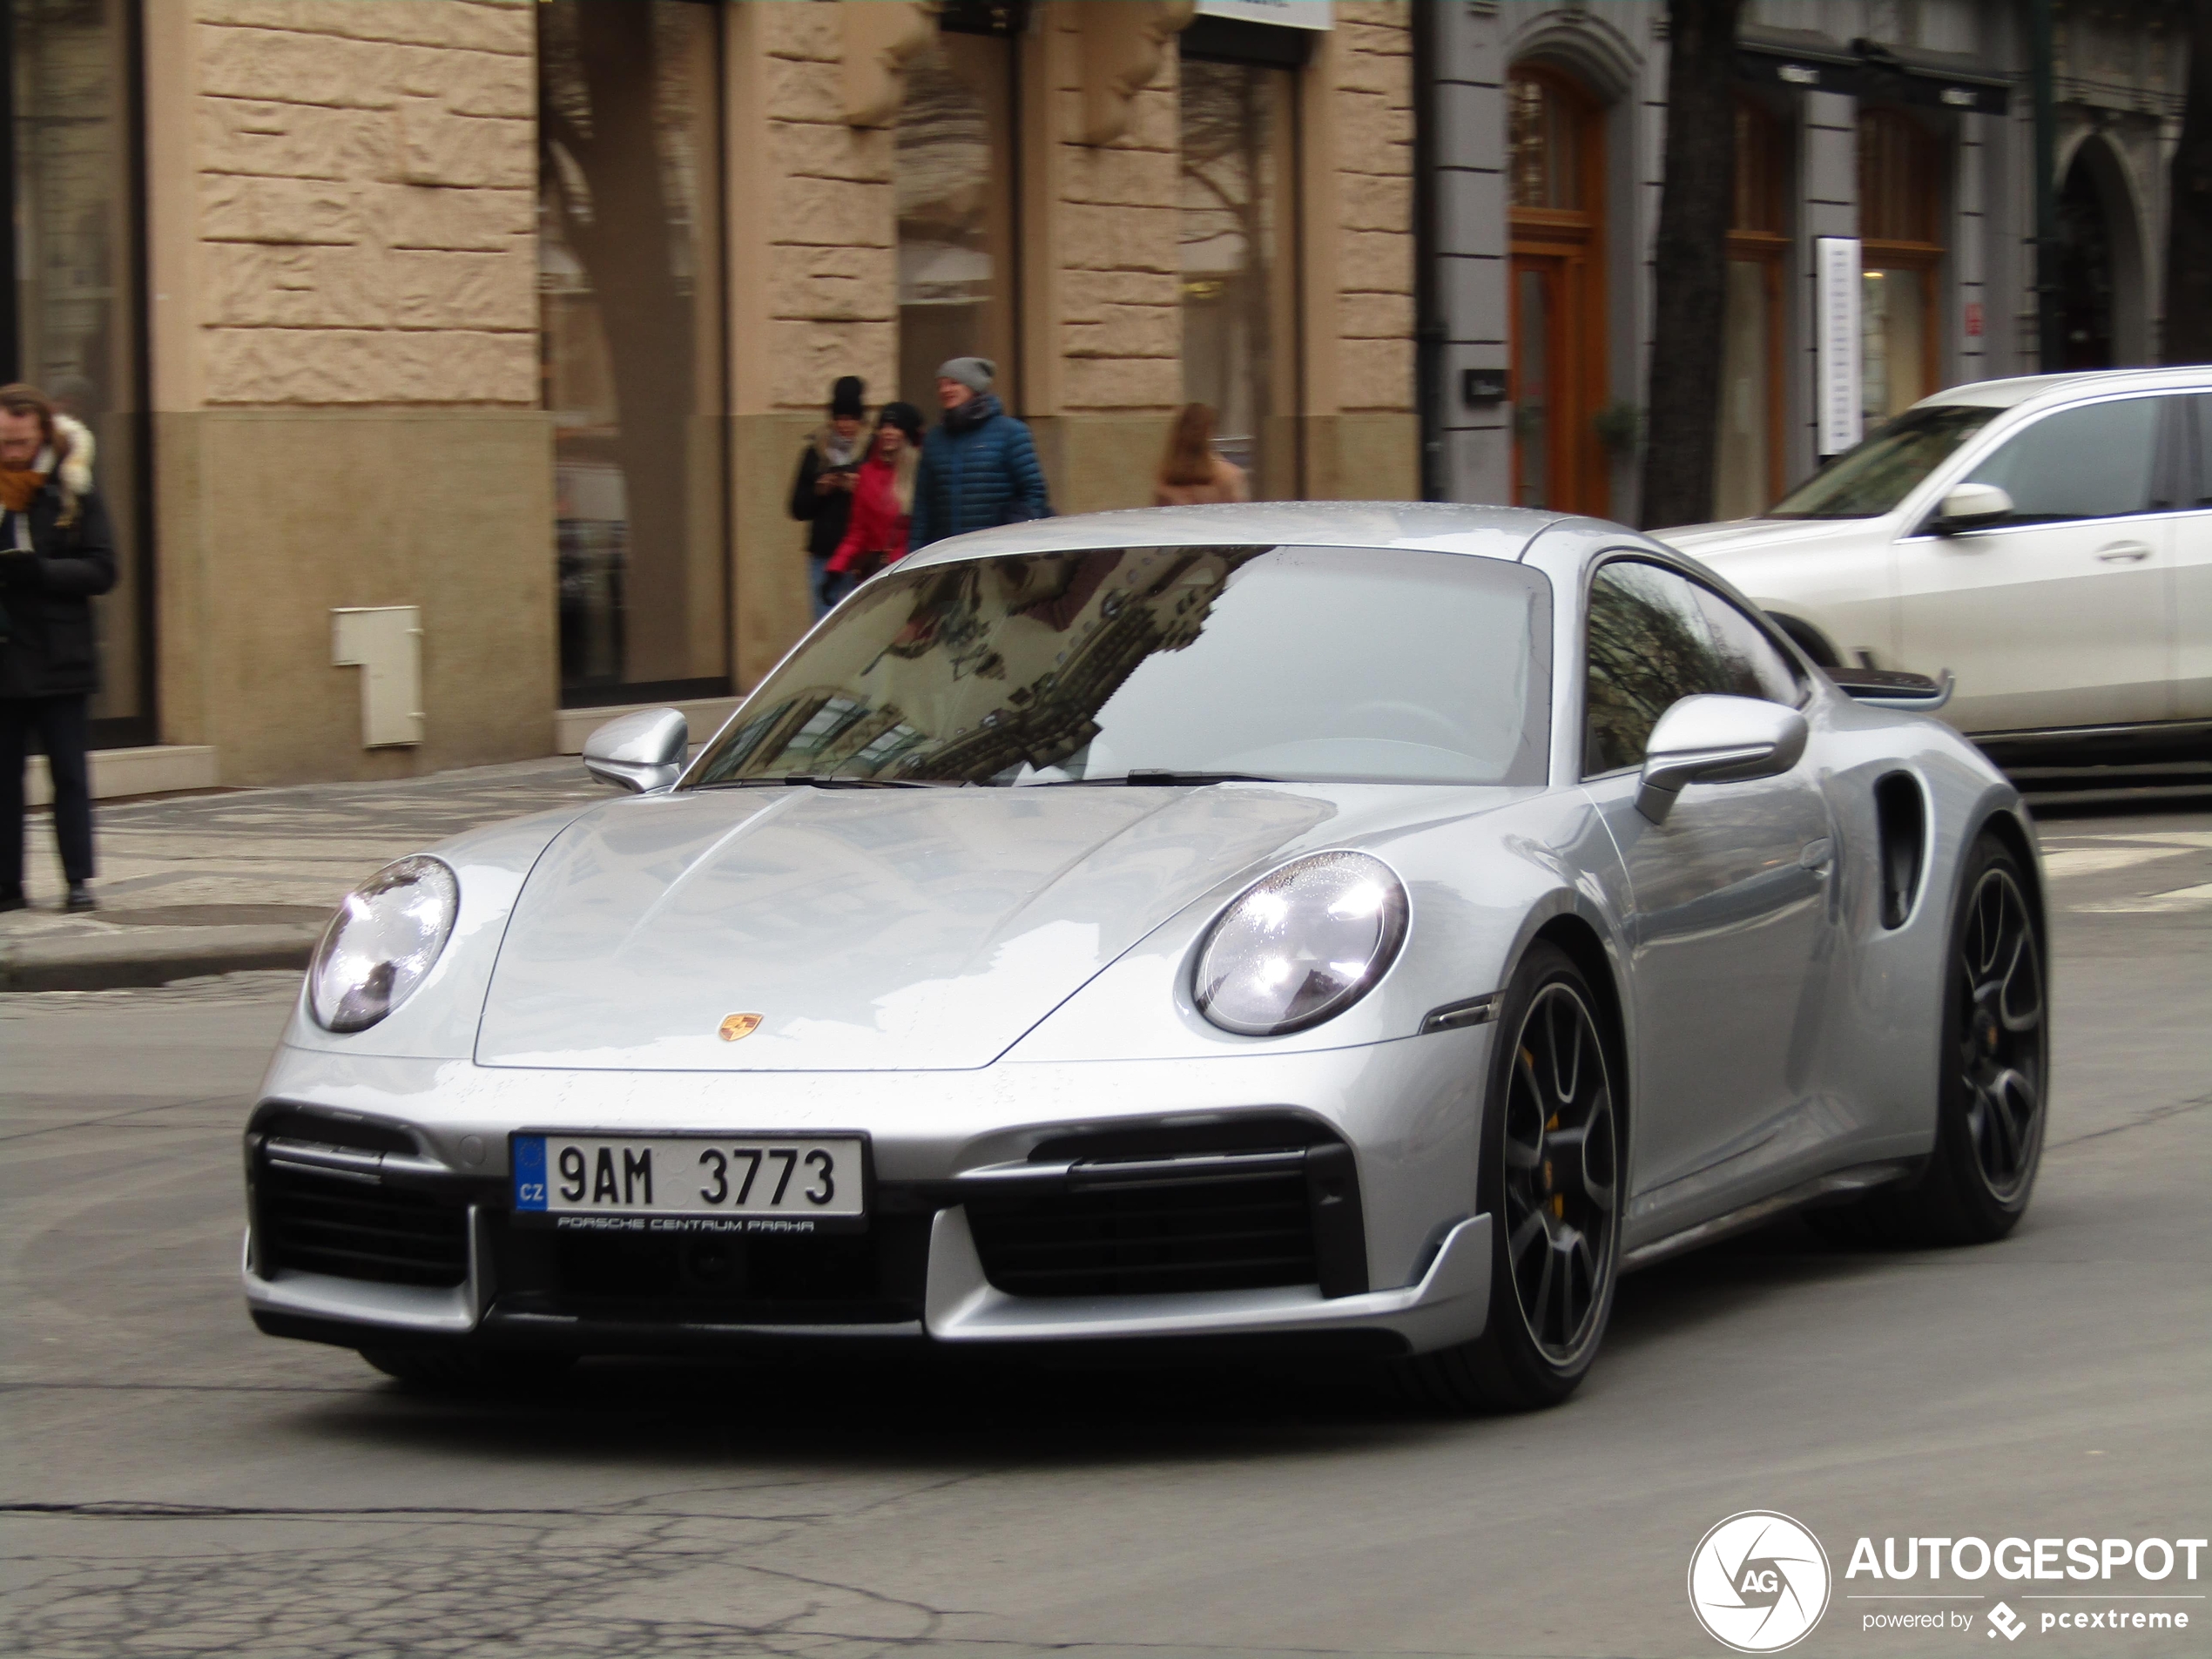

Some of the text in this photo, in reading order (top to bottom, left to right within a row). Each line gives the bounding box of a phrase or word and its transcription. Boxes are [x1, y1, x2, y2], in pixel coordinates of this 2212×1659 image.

[558, 1144, 835, 1205] 9AM 3773
[520, 1183, 544, 1201] CZ
[557, 1217, 814, 1232] PORSCHE CENTRUM PRAHA
